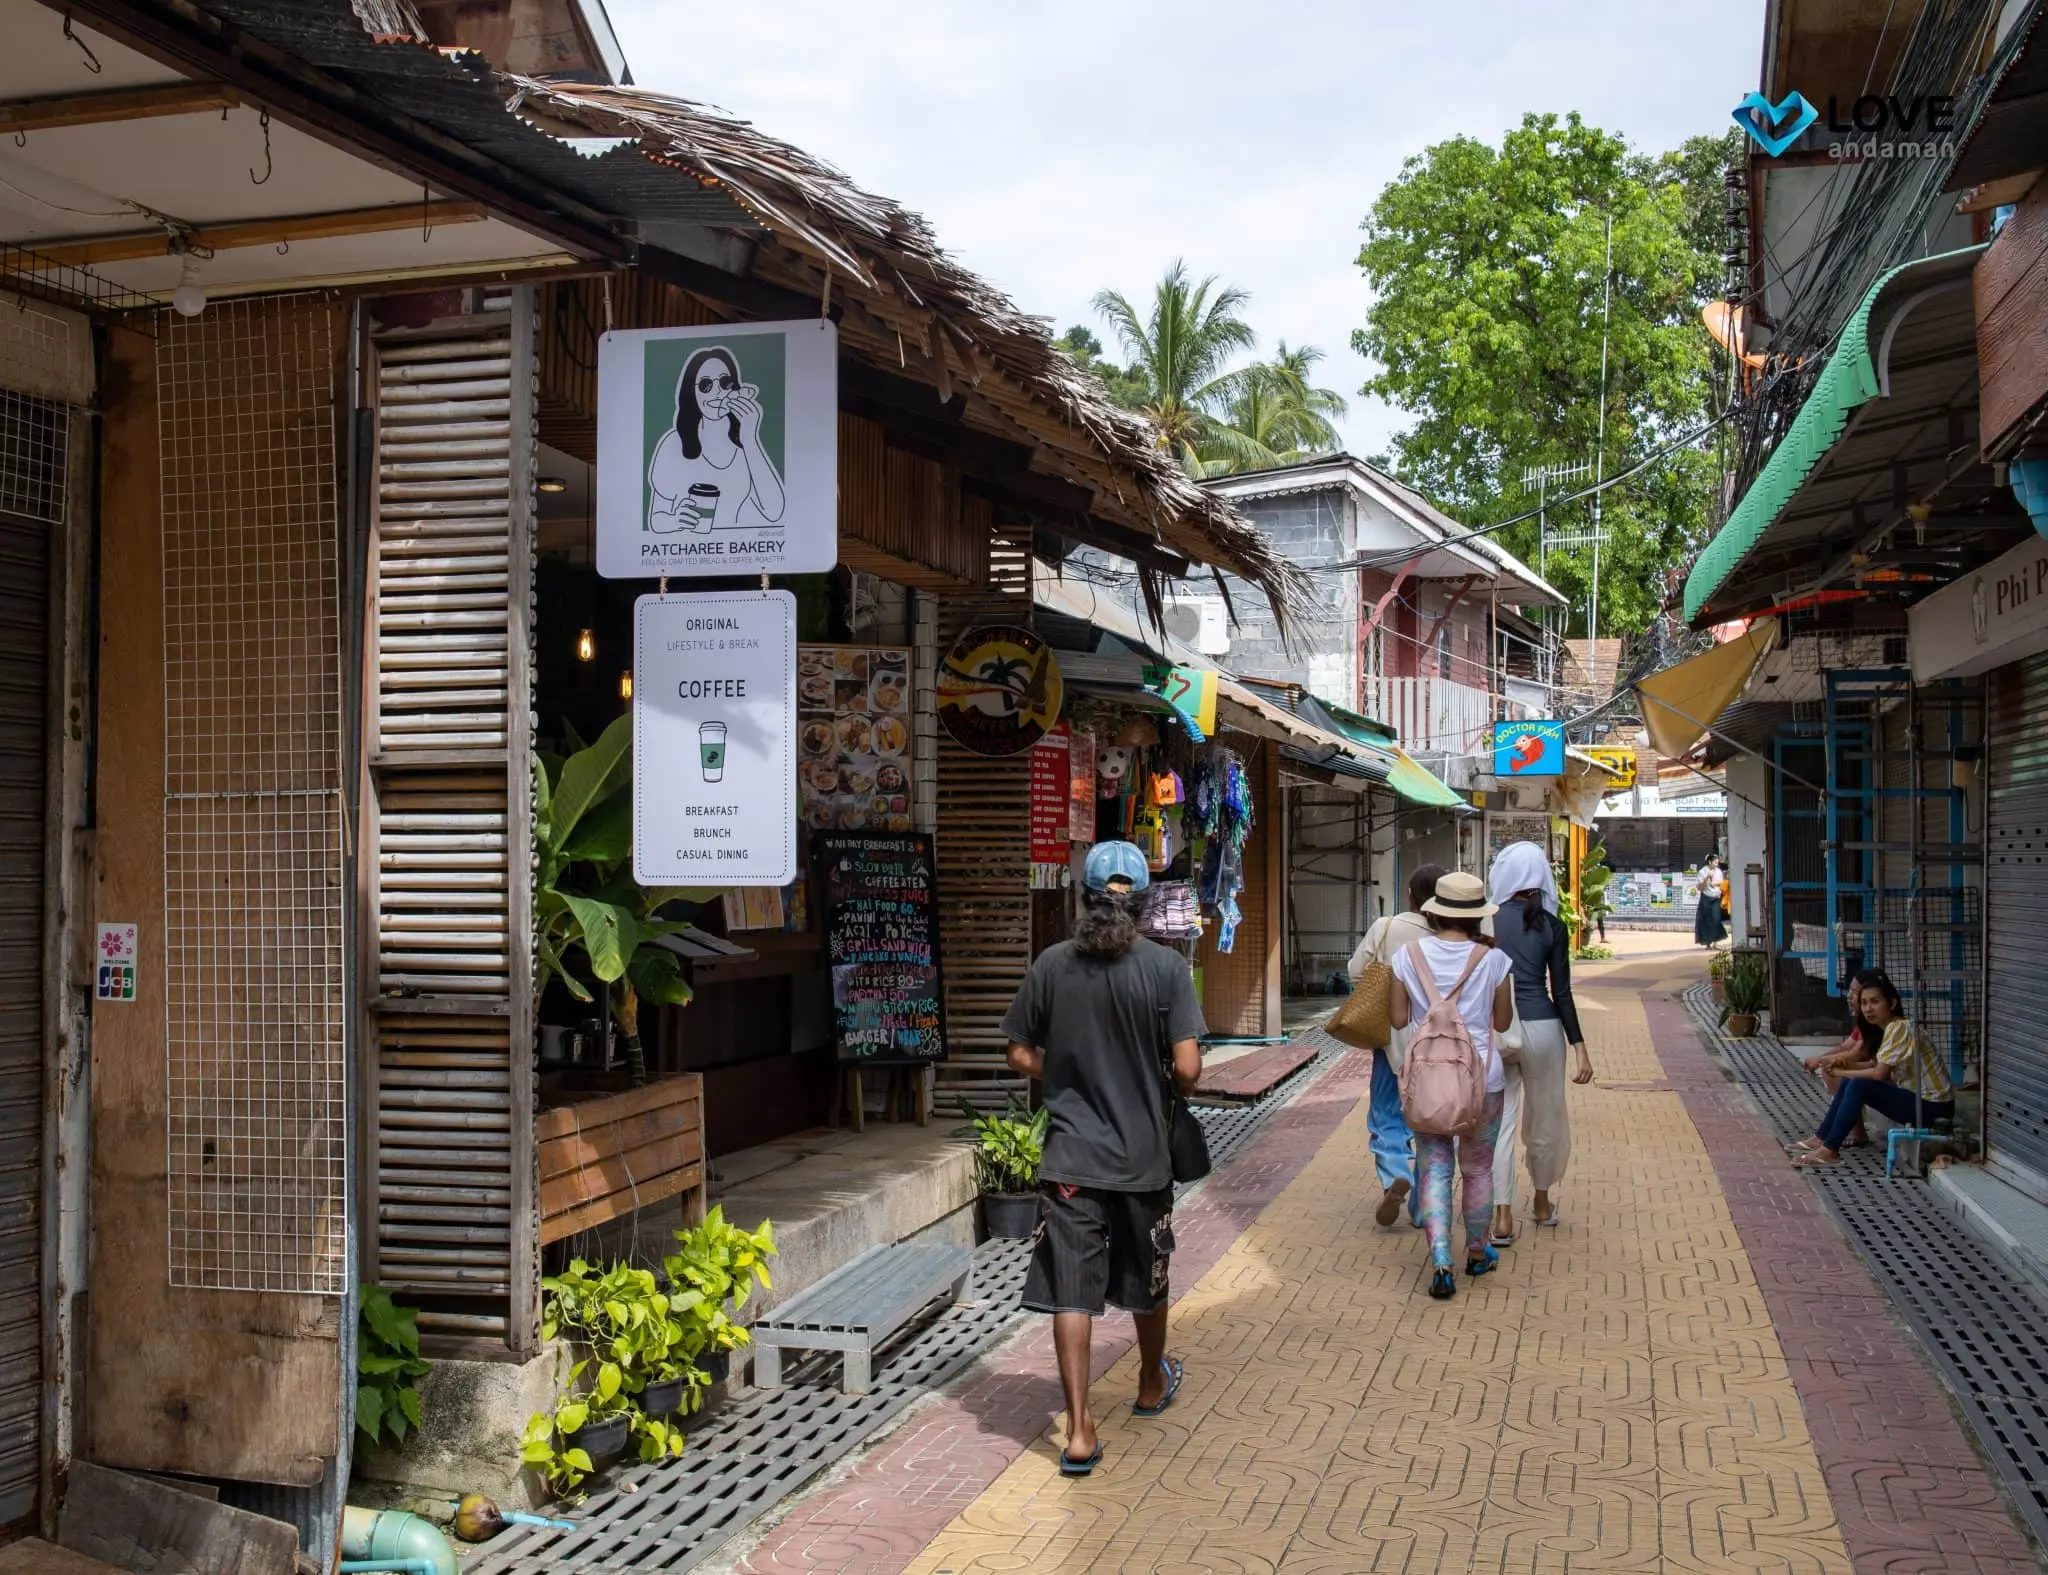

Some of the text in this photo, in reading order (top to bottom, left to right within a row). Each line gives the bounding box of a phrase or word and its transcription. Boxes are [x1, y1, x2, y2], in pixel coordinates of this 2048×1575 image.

[641, 540, 785, 556] PATCHAREE BAKERY
[1996, 566, 2028, 615] Phi
[686, 618, 740, 631] ORIGINAL
[667, 638, 759, 651] LIFESTYLE & BREAK
[678, 679, 746, 698] COFFEE
[1495, 722, 1560, 744] DOCTOR FISH
[685, 806, 739, 816] BREAKFAST
[693, 828, 731, 838] BRUNCH
[676, 849, 749, 860] CASUAL DINING
[99, 976, 132, 988] JCB
[844, 1028, 888, 1047] BURGER
